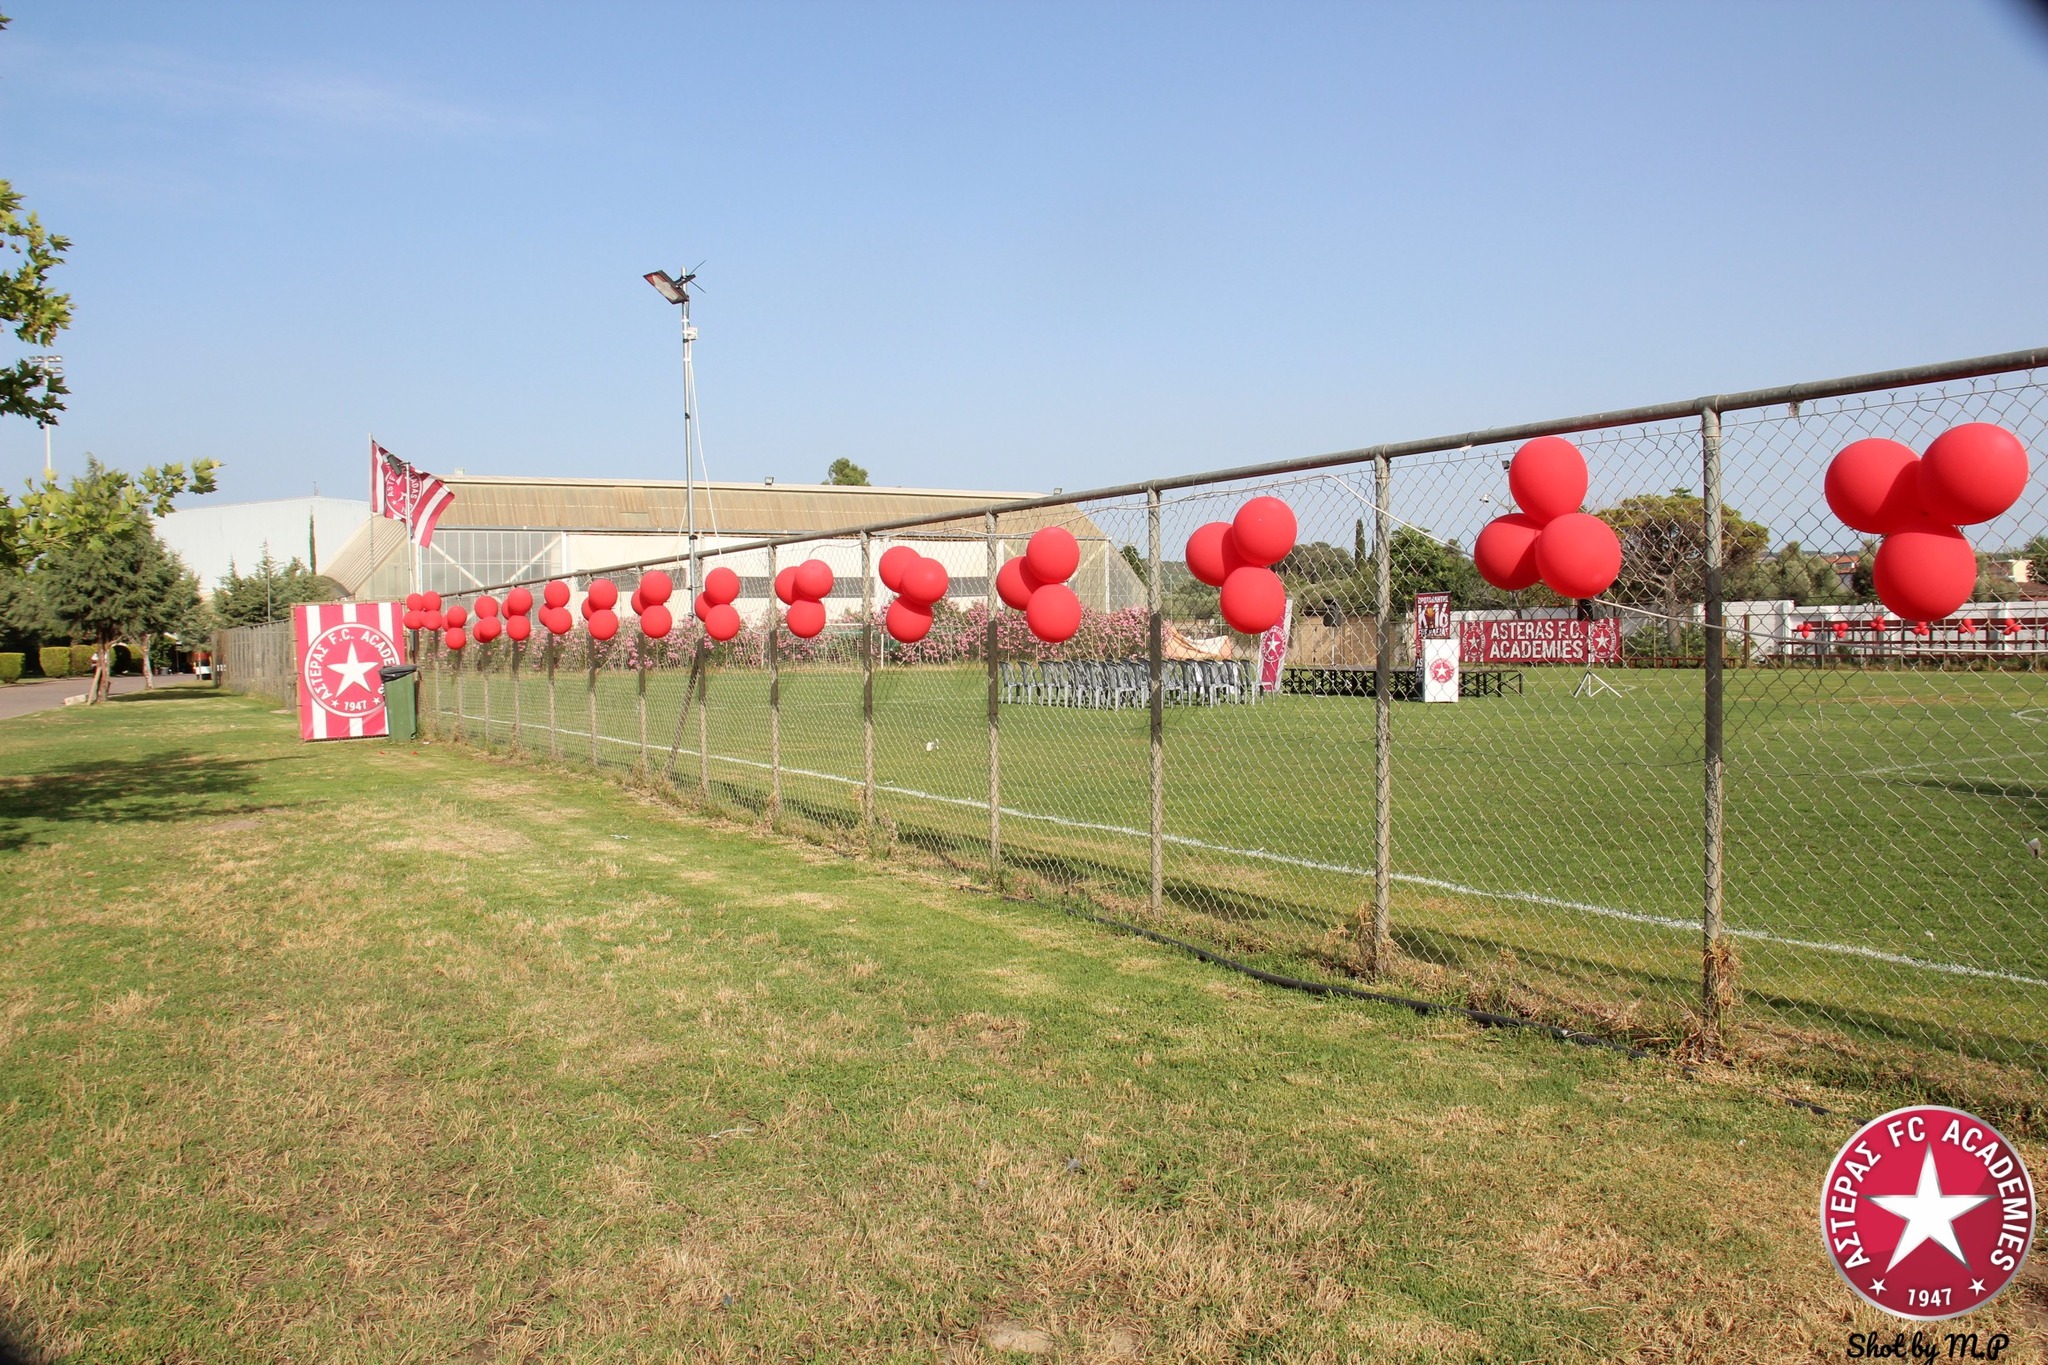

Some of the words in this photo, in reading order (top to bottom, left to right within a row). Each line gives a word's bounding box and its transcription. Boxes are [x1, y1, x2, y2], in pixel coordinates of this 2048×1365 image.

[328, 628, 355, 645] F.C.
[1490, 621, 1554, 640] ASTERAS
[1558, 621, 1584, 639] F.C.
[1489, 640, 1583, 659] ACADEMIES
[344, 700, 367, 711] 1947
